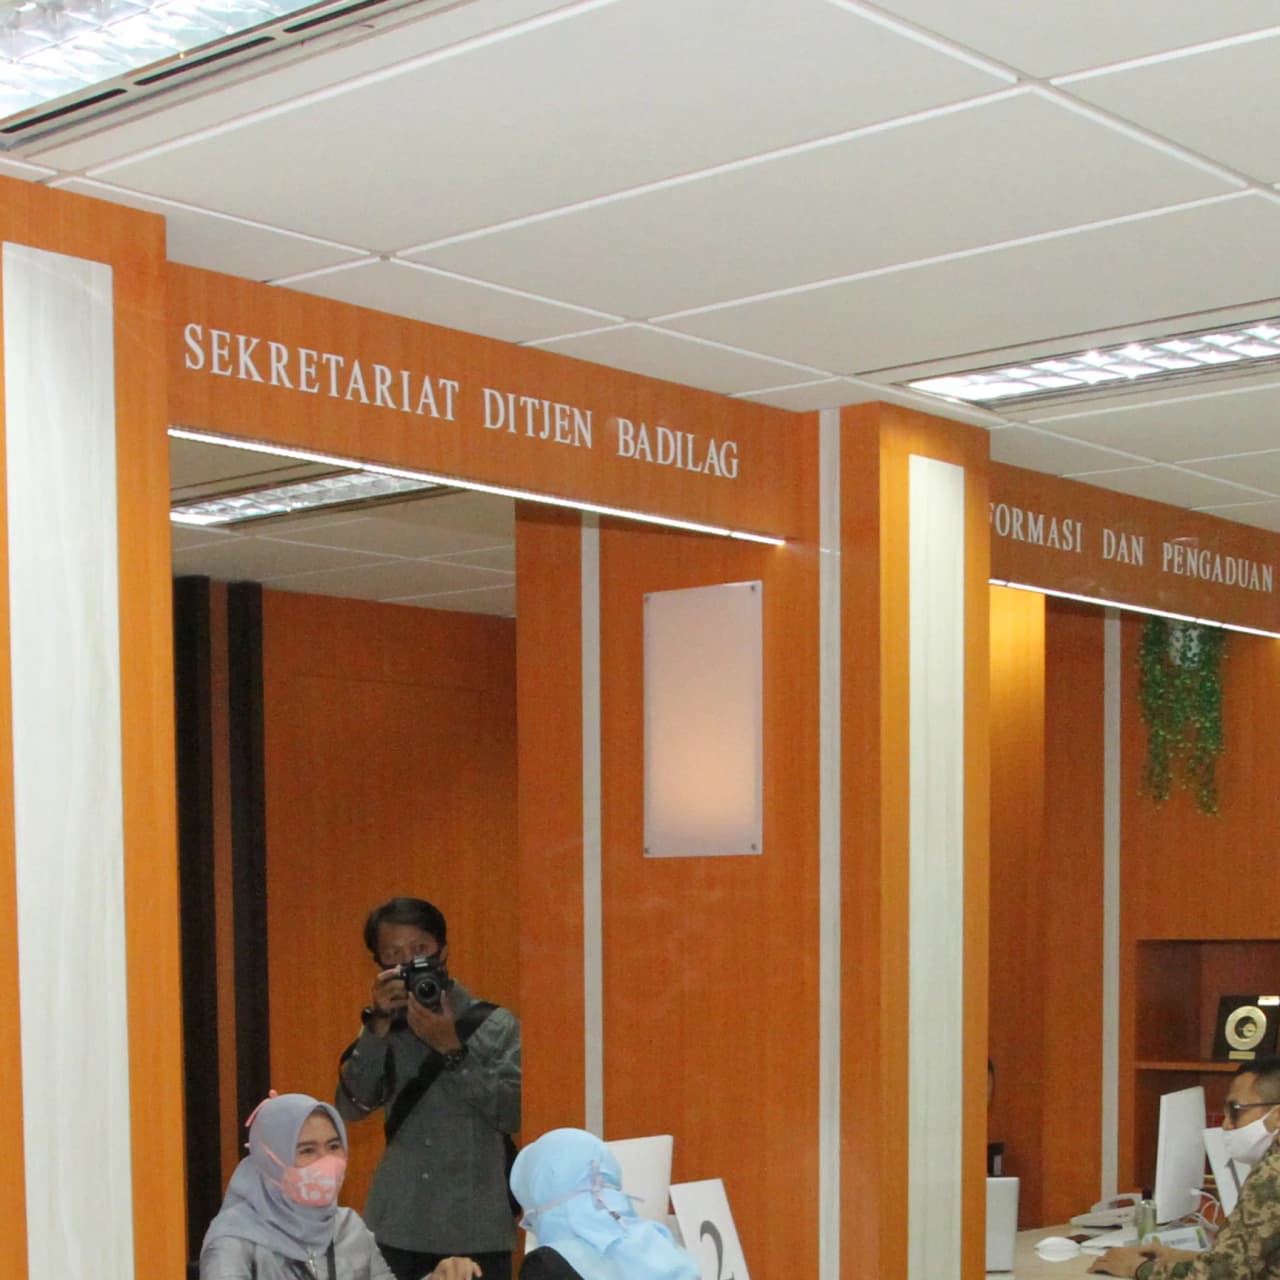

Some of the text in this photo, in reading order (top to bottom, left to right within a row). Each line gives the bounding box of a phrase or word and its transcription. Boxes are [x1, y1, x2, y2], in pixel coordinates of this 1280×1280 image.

[184, 322, 739, 479] SEKRETARIAT DITJEN BADILAG
[1103, 528, 1145, 567] DAN
[1162, 542, 1273, 593] PENGADUAN
